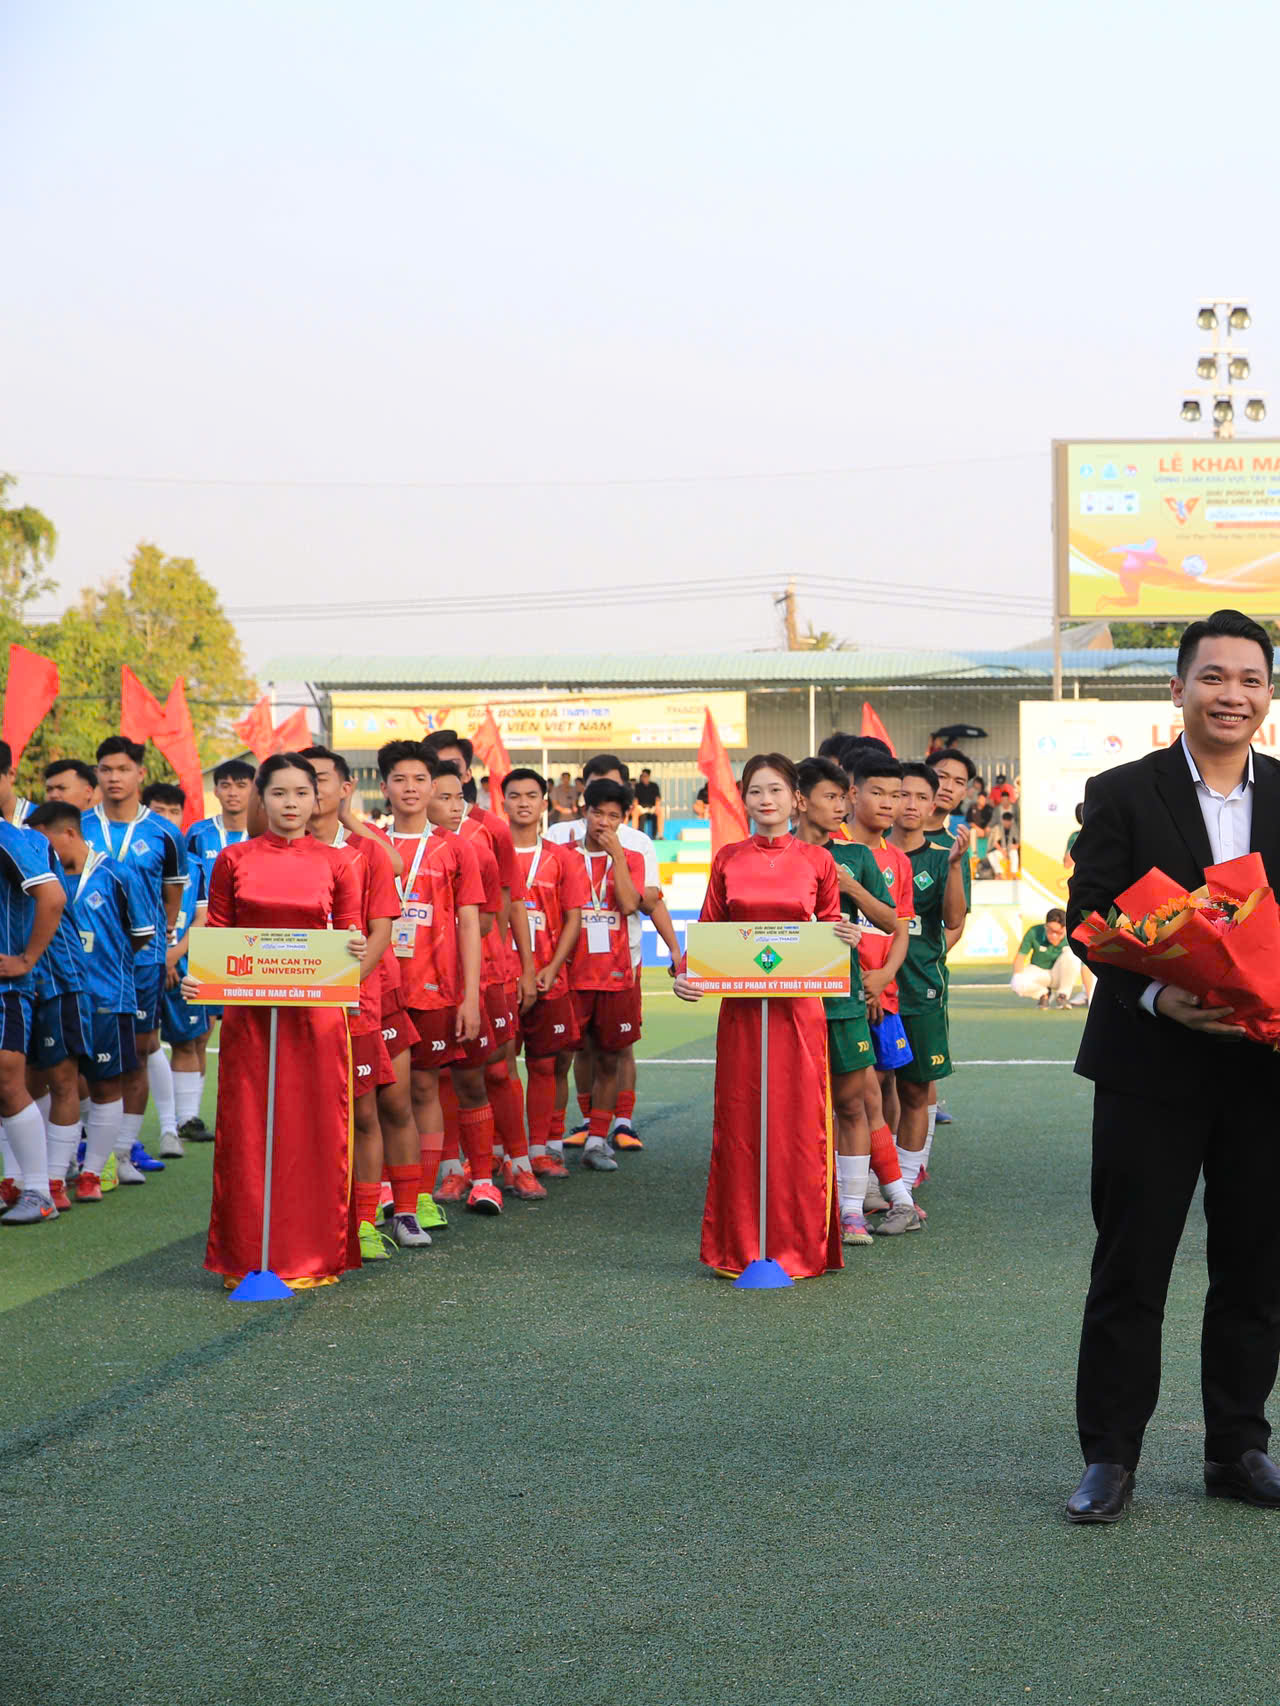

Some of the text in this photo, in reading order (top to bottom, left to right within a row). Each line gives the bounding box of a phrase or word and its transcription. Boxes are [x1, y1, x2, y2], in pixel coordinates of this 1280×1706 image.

[1159, 451, 1184, 473] LỄ
[1192, 457, 1243, 473] KHAI
[578, 719, 612, 732] NAM
[257, 958, 322, 968] NAM CAN THO
[261, 967, 317, 976] UNIVERSITY
[824, 981, 844, 990] LONG
[267, 989, 287, 998] NAM
[288, 986, 305, 998] CẦN
